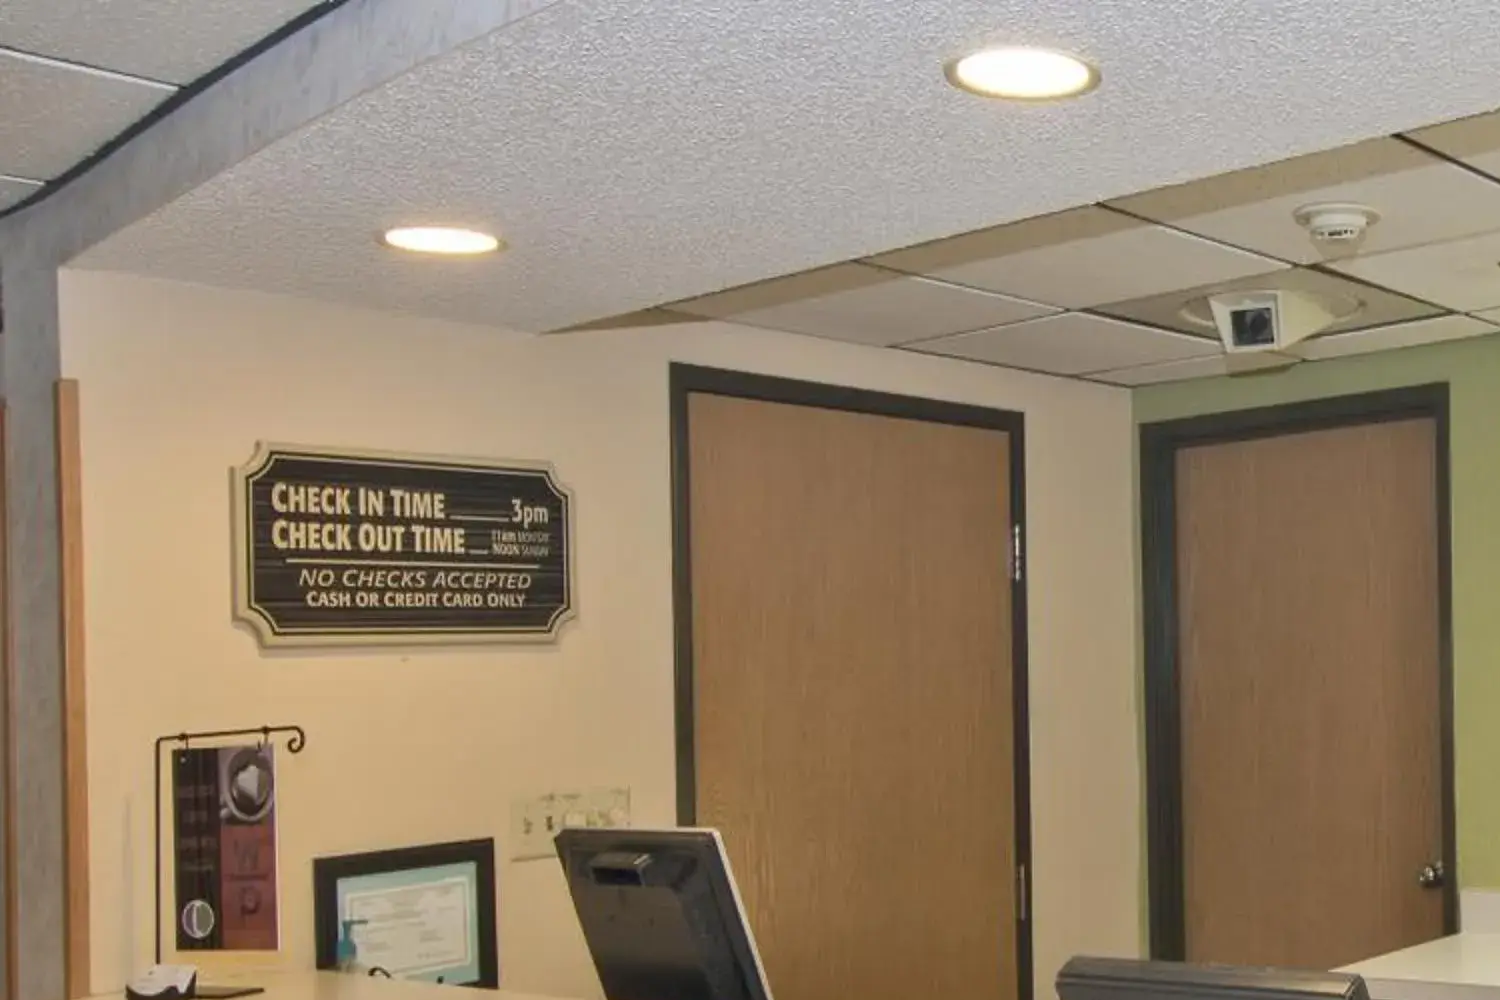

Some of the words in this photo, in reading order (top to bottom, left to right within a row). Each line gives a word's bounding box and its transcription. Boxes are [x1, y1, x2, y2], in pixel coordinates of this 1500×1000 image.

[271, 481, 351, 514] CHECK
[358, 487, 384, 517] IN
[390, 489, 446, 519] TIME
[511, 498, 549, 529] 3pm
[271, 518, 352, 551] CHECK
[358, 523, 404, 552] OUT
[411, 525, 465, 555] TIME
[299, 568, 335, 588] NO
[342, 569, 427, 589] CHECKS
[432, 571, 532, 590] ACCEPTED
[306, 591, 351, 608] CASH
[355, 592, 379, 608] OR
[383, 592, 439, 608] CREDIT
[442, 592, 483, 608] CARD
[487, 593, 526, 608] ONLY
